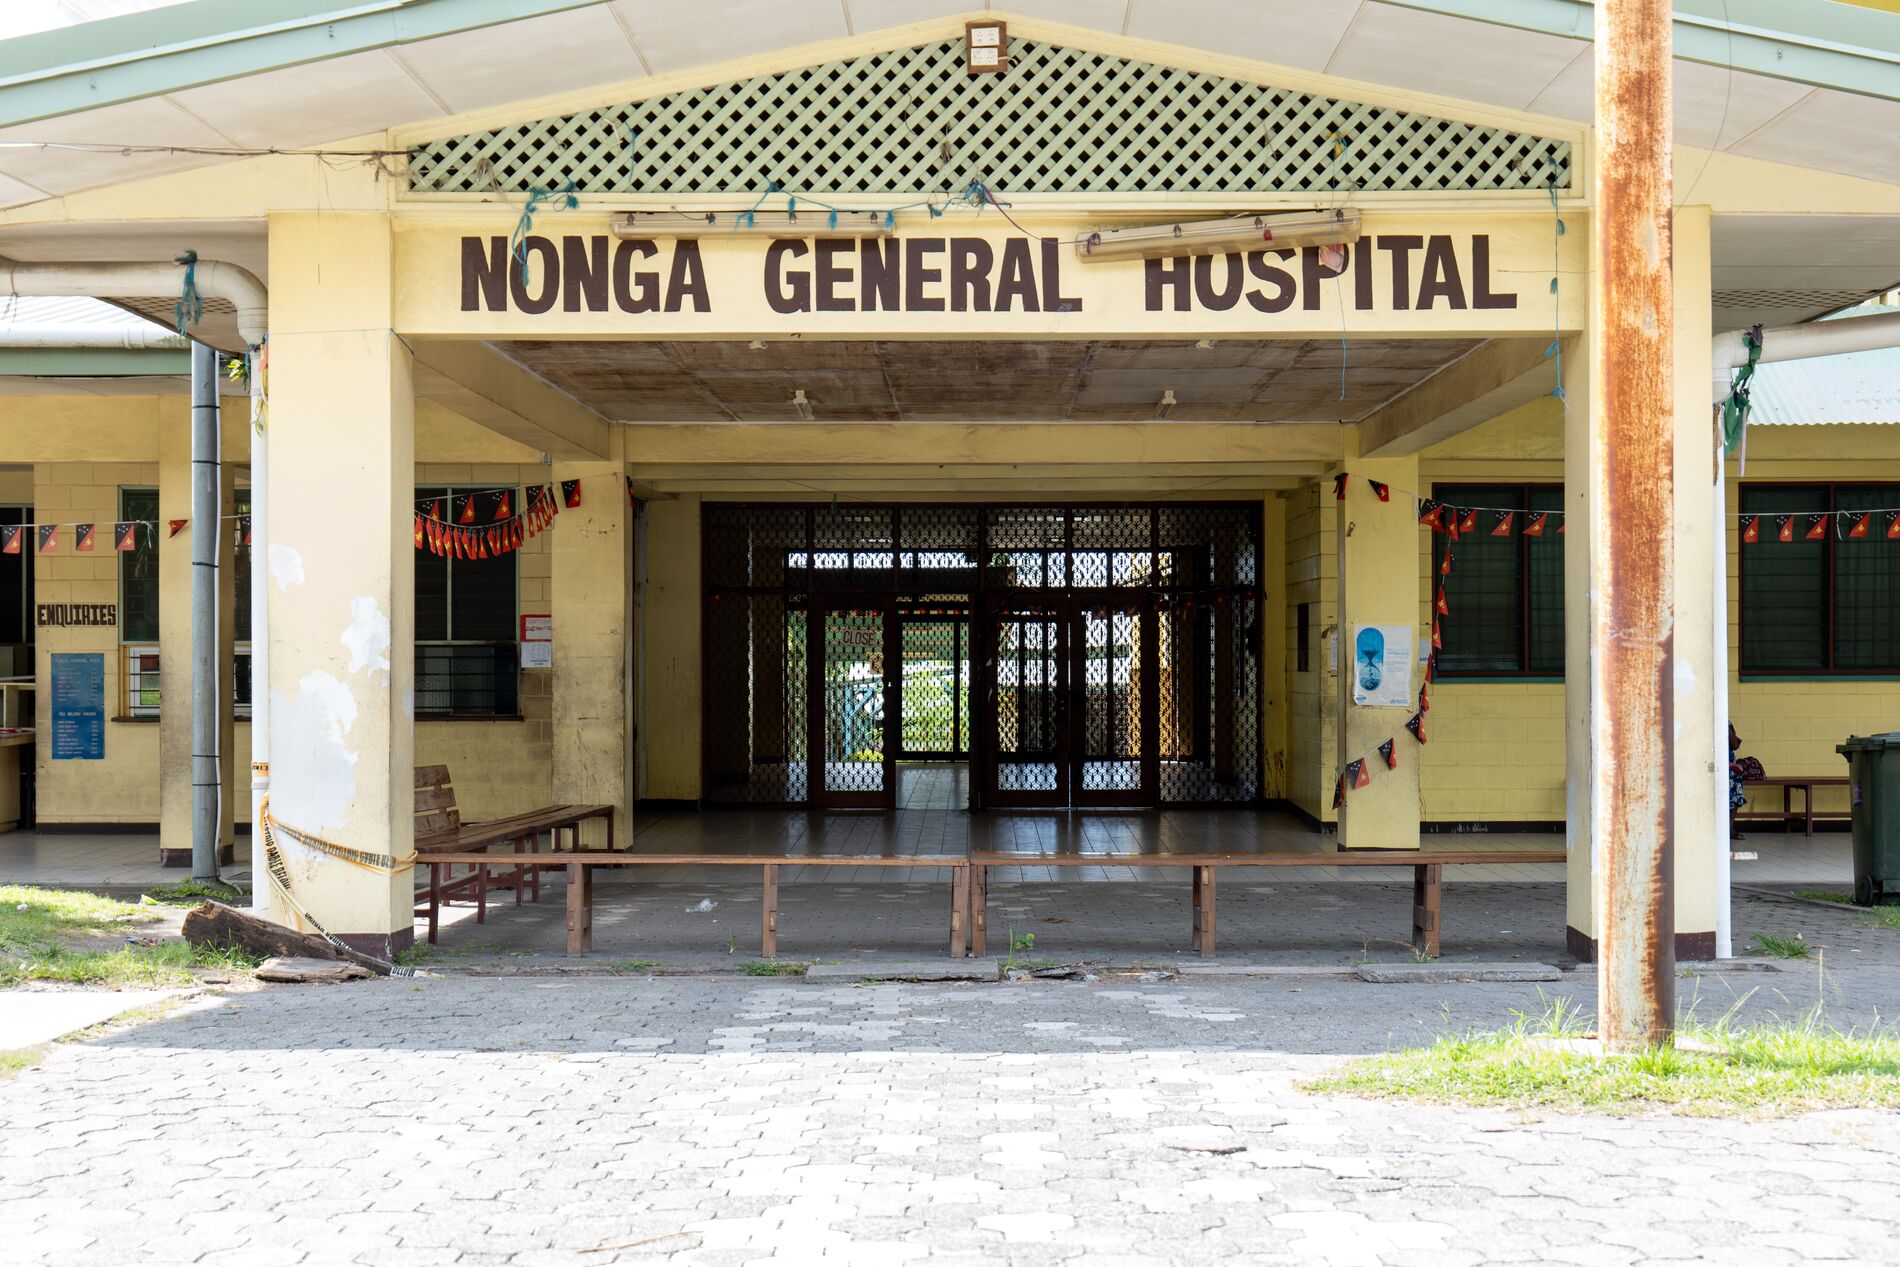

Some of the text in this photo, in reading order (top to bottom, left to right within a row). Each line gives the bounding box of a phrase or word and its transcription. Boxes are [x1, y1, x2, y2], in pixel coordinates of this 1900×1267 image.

[461, 235, 1518, 314] NONGA GENERAL HOSPITAL
[37, 604, 117, 627] ENQUIRIES
[843, 630, 875, 646] CLOSE
